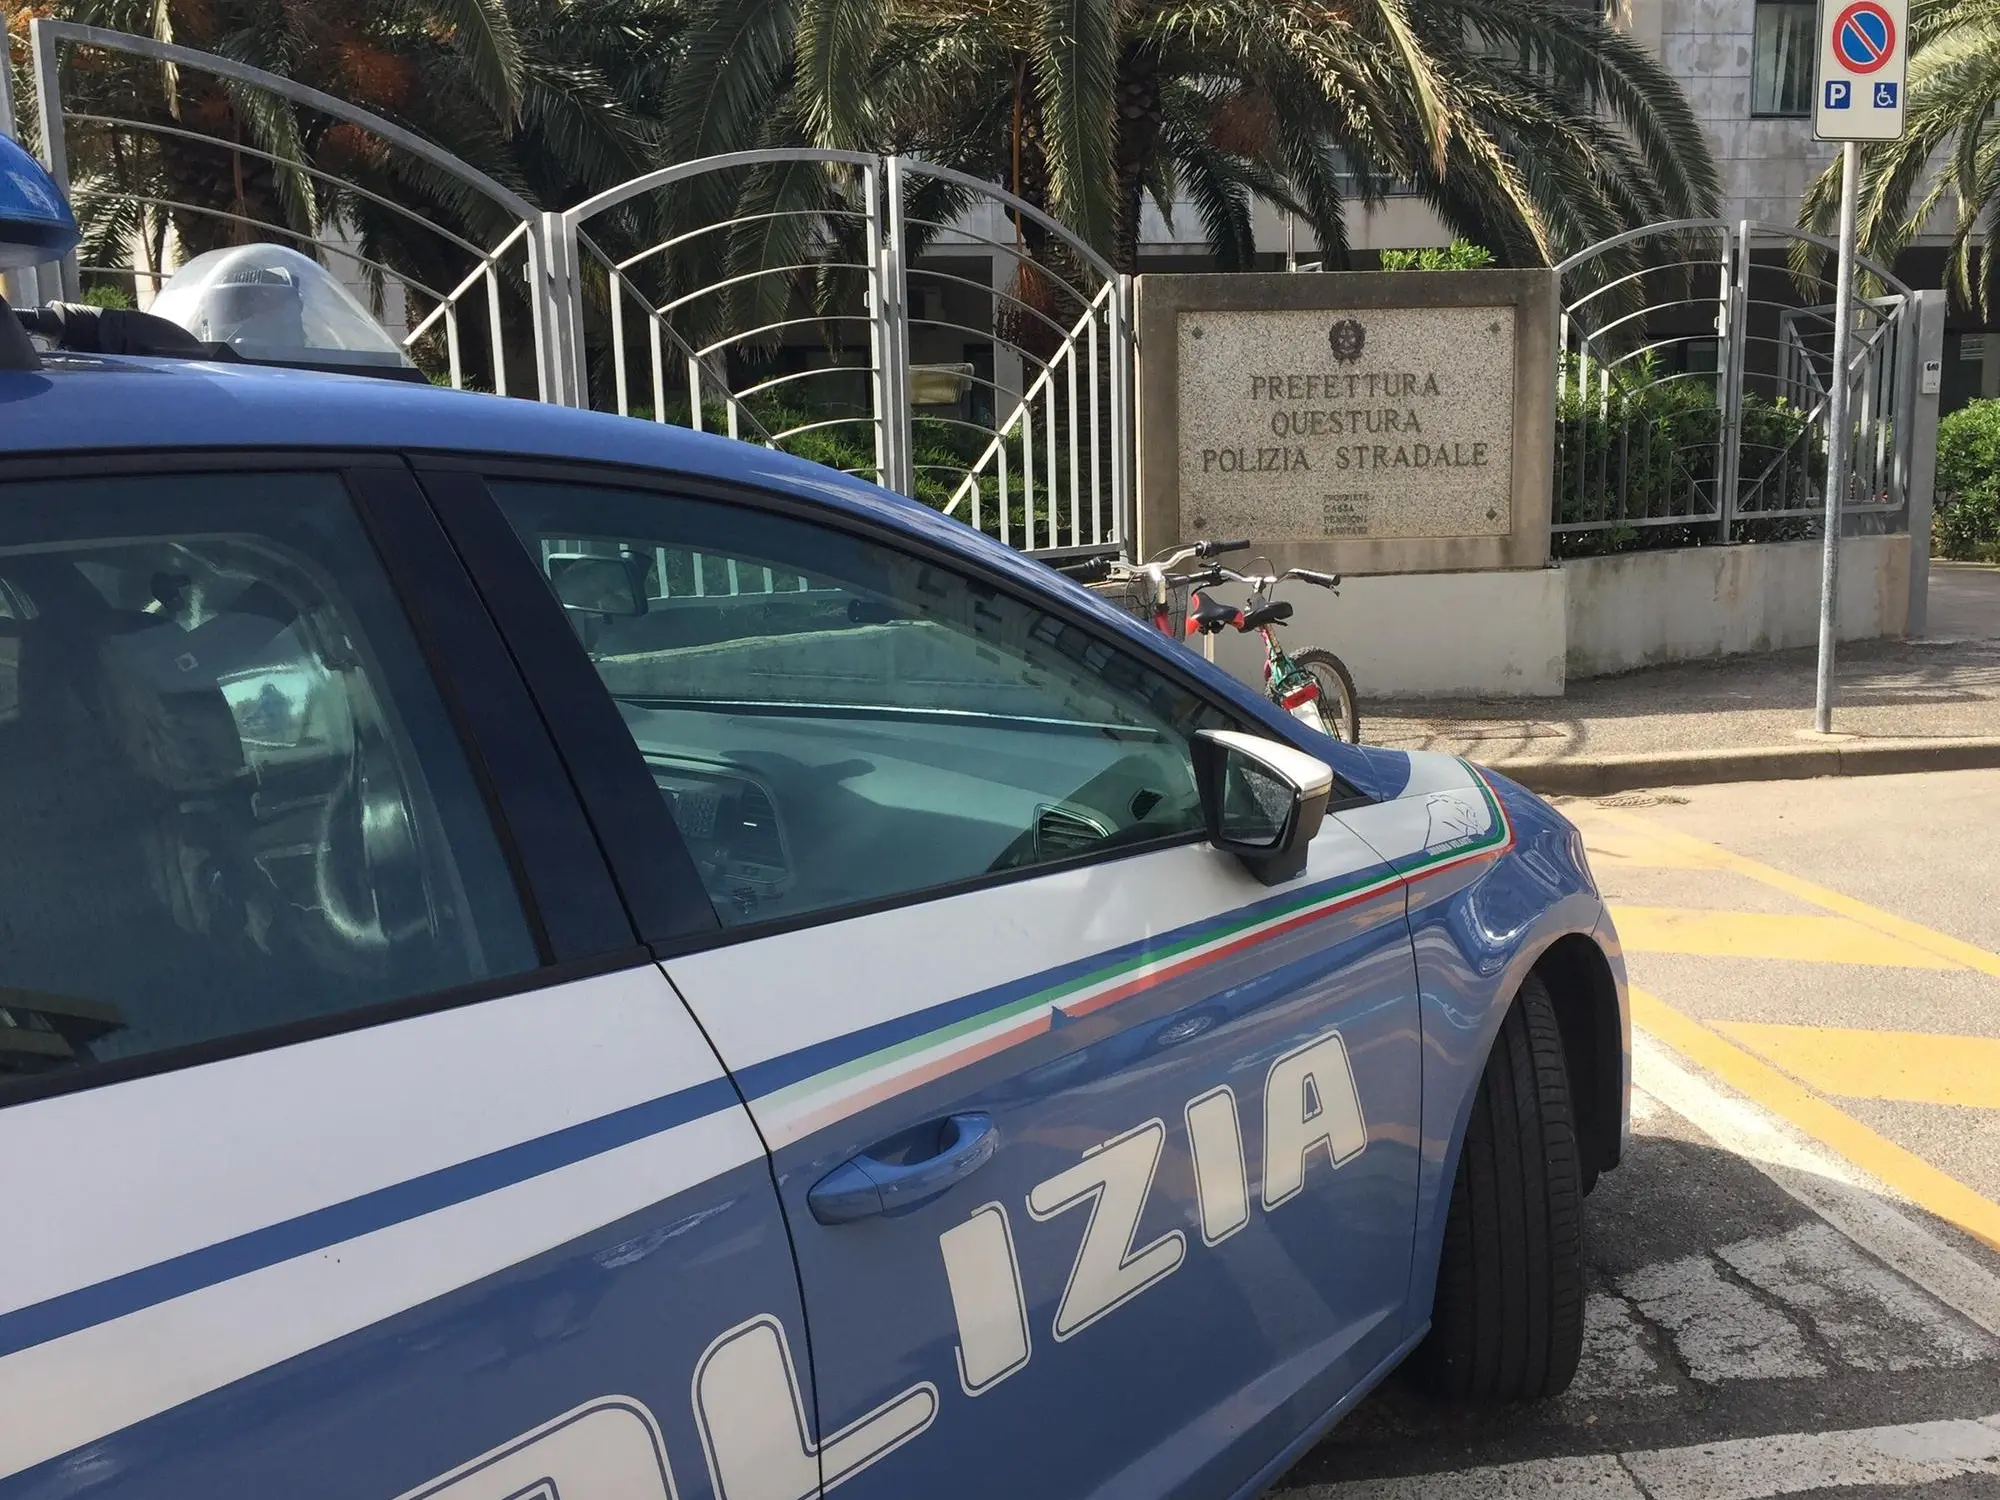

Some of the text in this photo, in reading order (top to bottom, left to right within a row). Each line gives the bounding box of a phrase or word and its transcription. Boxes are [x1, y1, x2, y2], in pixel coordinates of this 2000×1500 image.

[1829, 83, 1847, 107] P
[1250, 372, 1441, 400] PREFETTURA
[1271, 409, 1422, 438] QUESTURA
[1202, 441, 1489, 473] POLIZIA STRADALE
